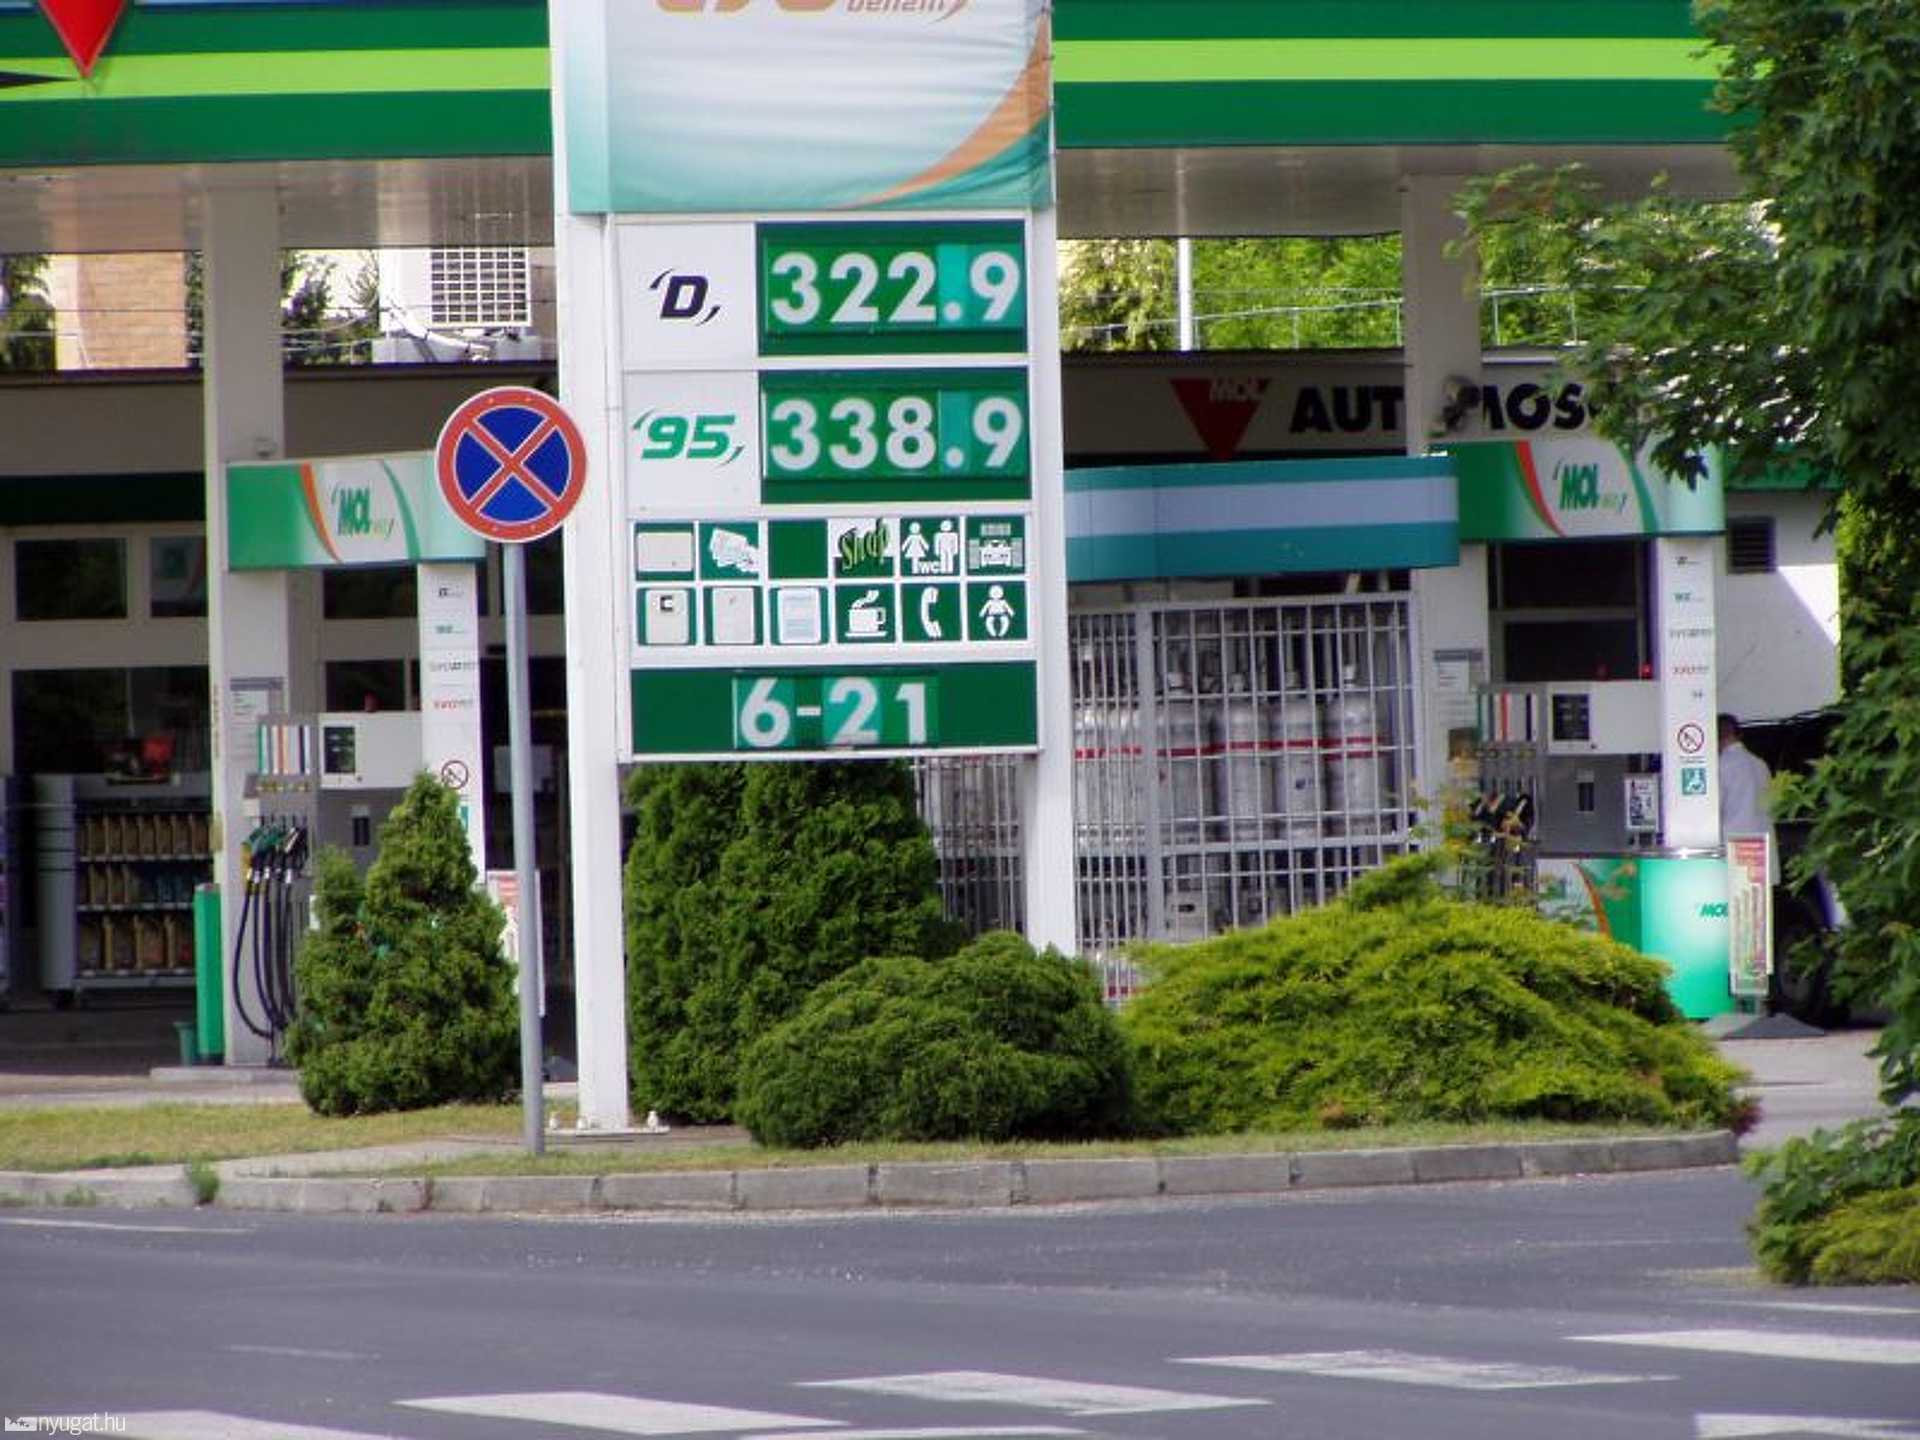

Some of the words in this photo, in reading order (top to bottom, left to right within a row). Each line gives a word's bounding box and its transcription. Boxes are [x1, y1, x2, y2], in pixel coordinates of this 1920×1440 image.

[770, 251, 1019, 324] 322.9
[770, 396, 1023, 471] 338.9
[740, 676, 928, 748] 6-21
